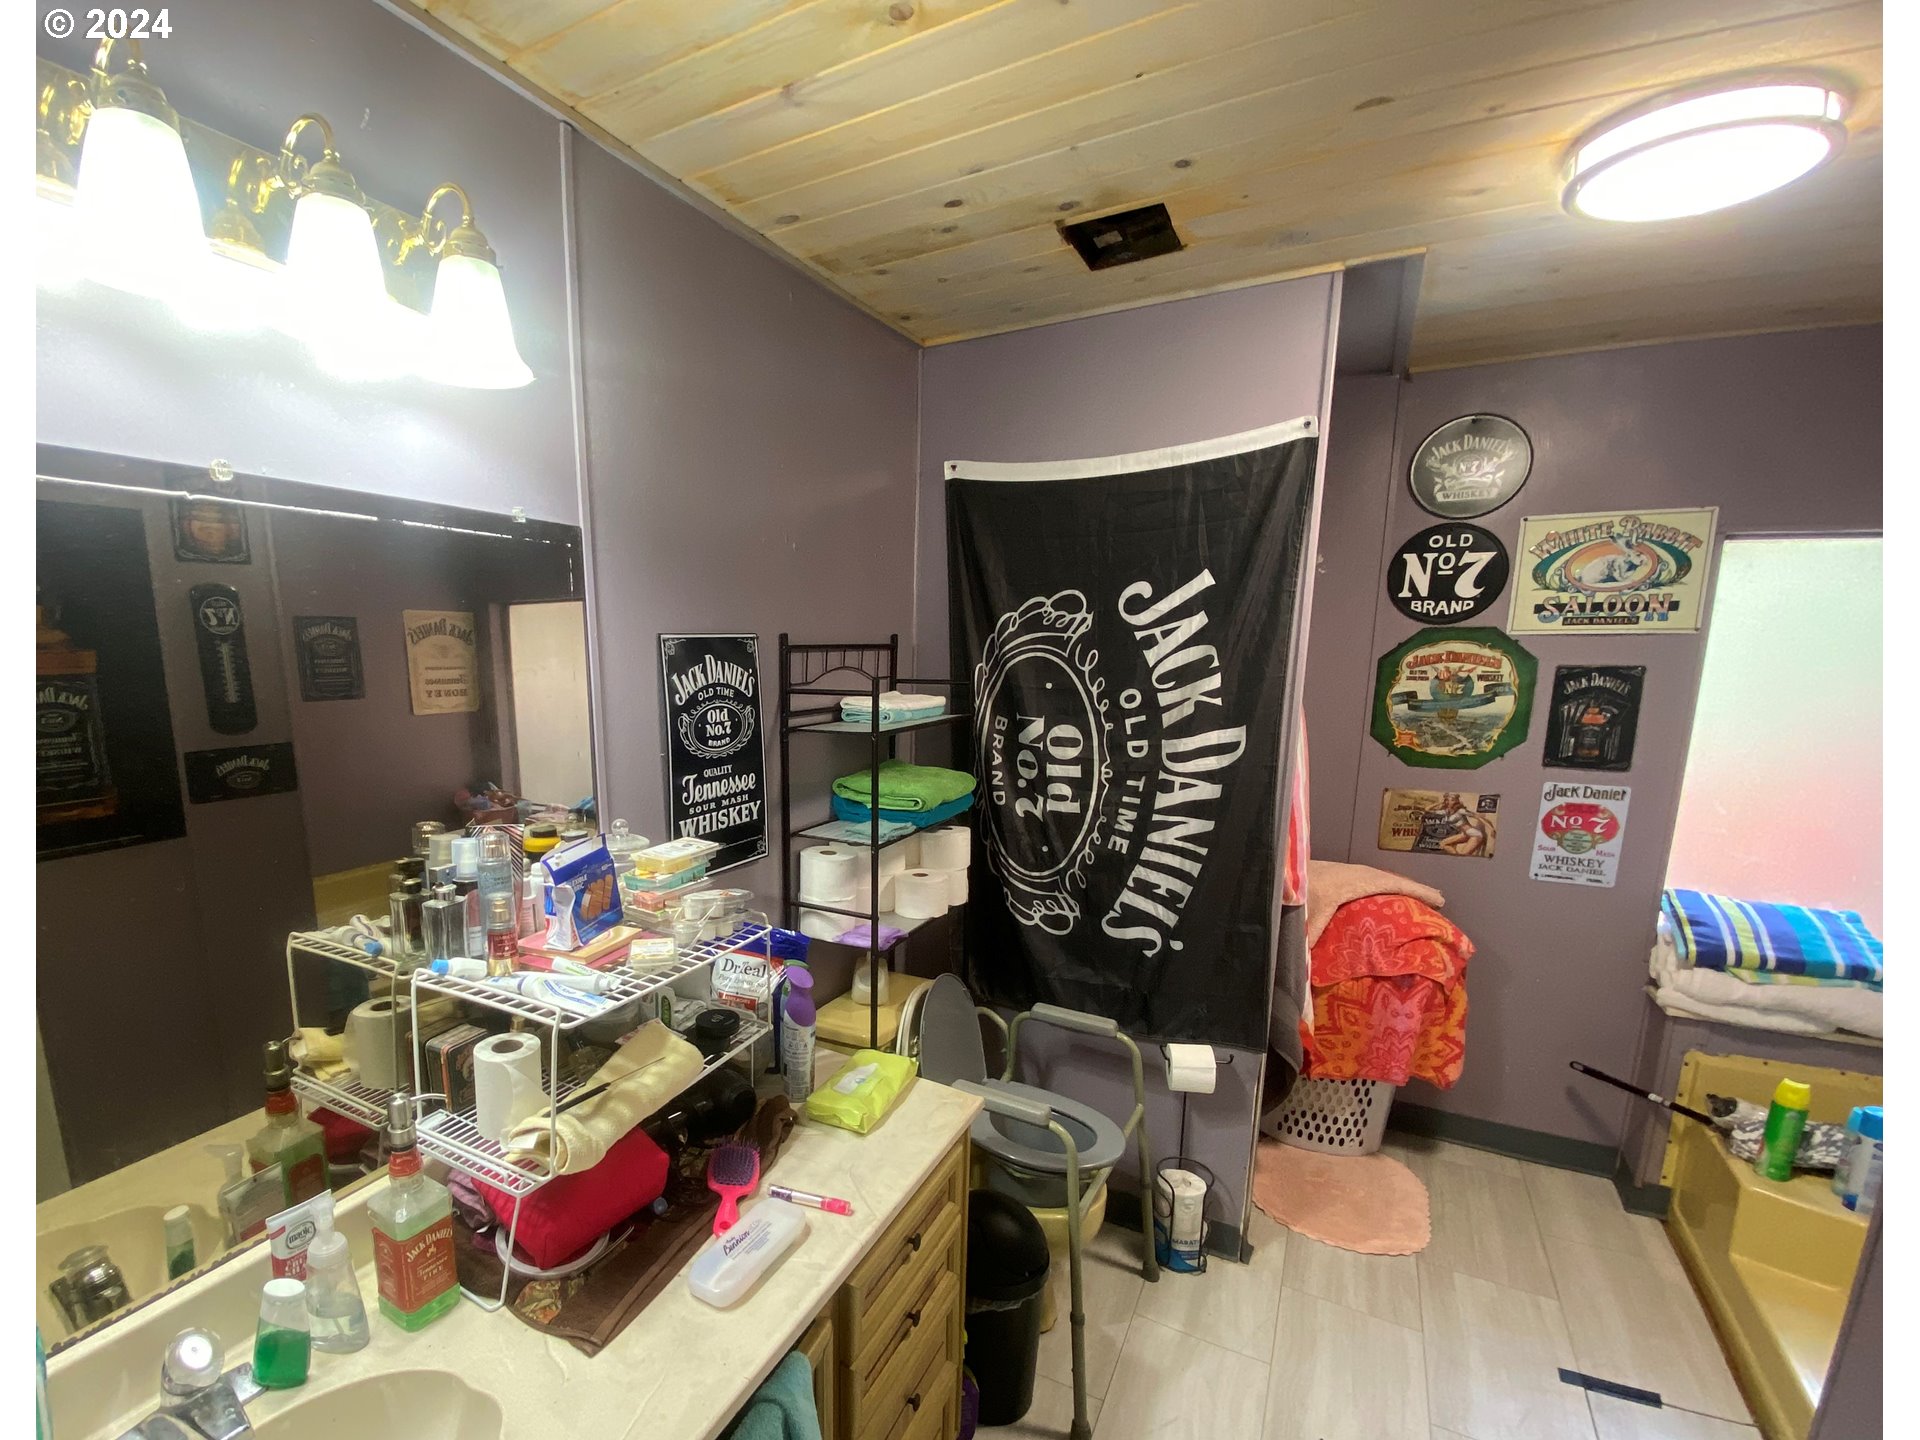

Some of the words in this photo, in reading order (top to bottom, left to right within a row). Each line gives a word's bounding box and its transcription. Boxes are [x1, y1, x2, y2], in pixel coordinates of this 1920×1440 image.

[1431, 438, 1462, 461] JACK
[1442, 488, 1492, 500] WHISKEY
[1429, 534, 1474, 548] OLD
[1529, 520, 1615, 560] WHITE
[1619, 515, 1703, 555] RABBIT
[1410, 600, 1475, 616] BRAND
[1537, 593, 1674, 624] SALOON
[1565, 617, 1590, 625] JACK
[1118, 568, 1223, 729] JACK
[671, 659, 708, 706] JACK
[704, 653, 755, 698] DANIEL'S
[1563, 675, 1589, 695] JACK
[697, 688, 714, 701] OLD
[716, 686, 735, 698] TIME
[707, 708, 729, 724] Old
[1119, 687, 1149, 759] OLD
[708, 737, 731, 747] BRAND
[990, 715, 1009, 806] BRAND
[1045, 723, 1084, 815] Old
[703, 765, 732, 778] QUALITY
[682, 772, 756, 806] Tennessee
[1543, 784, 1581, 801] Jack
[1583, 786, 1627, 801] Daniel
[689, 801, 717, 815] SOUR
[721, 794, 749, 807] MASH
[679, 800, 762, 838] WHISKEY
[1107, 775, 1149, 855] TIME
[1588, 817, 1611, 834] 7
[1101, 725, 1247, 958] DANIEL'S
[1538, 863, 1564, 872] JACK
[1544, 854, 1606, 869] WHISKEY
[289, 1225, 312, 1245] magic
[406, 1241, 426, 1263] JACK
